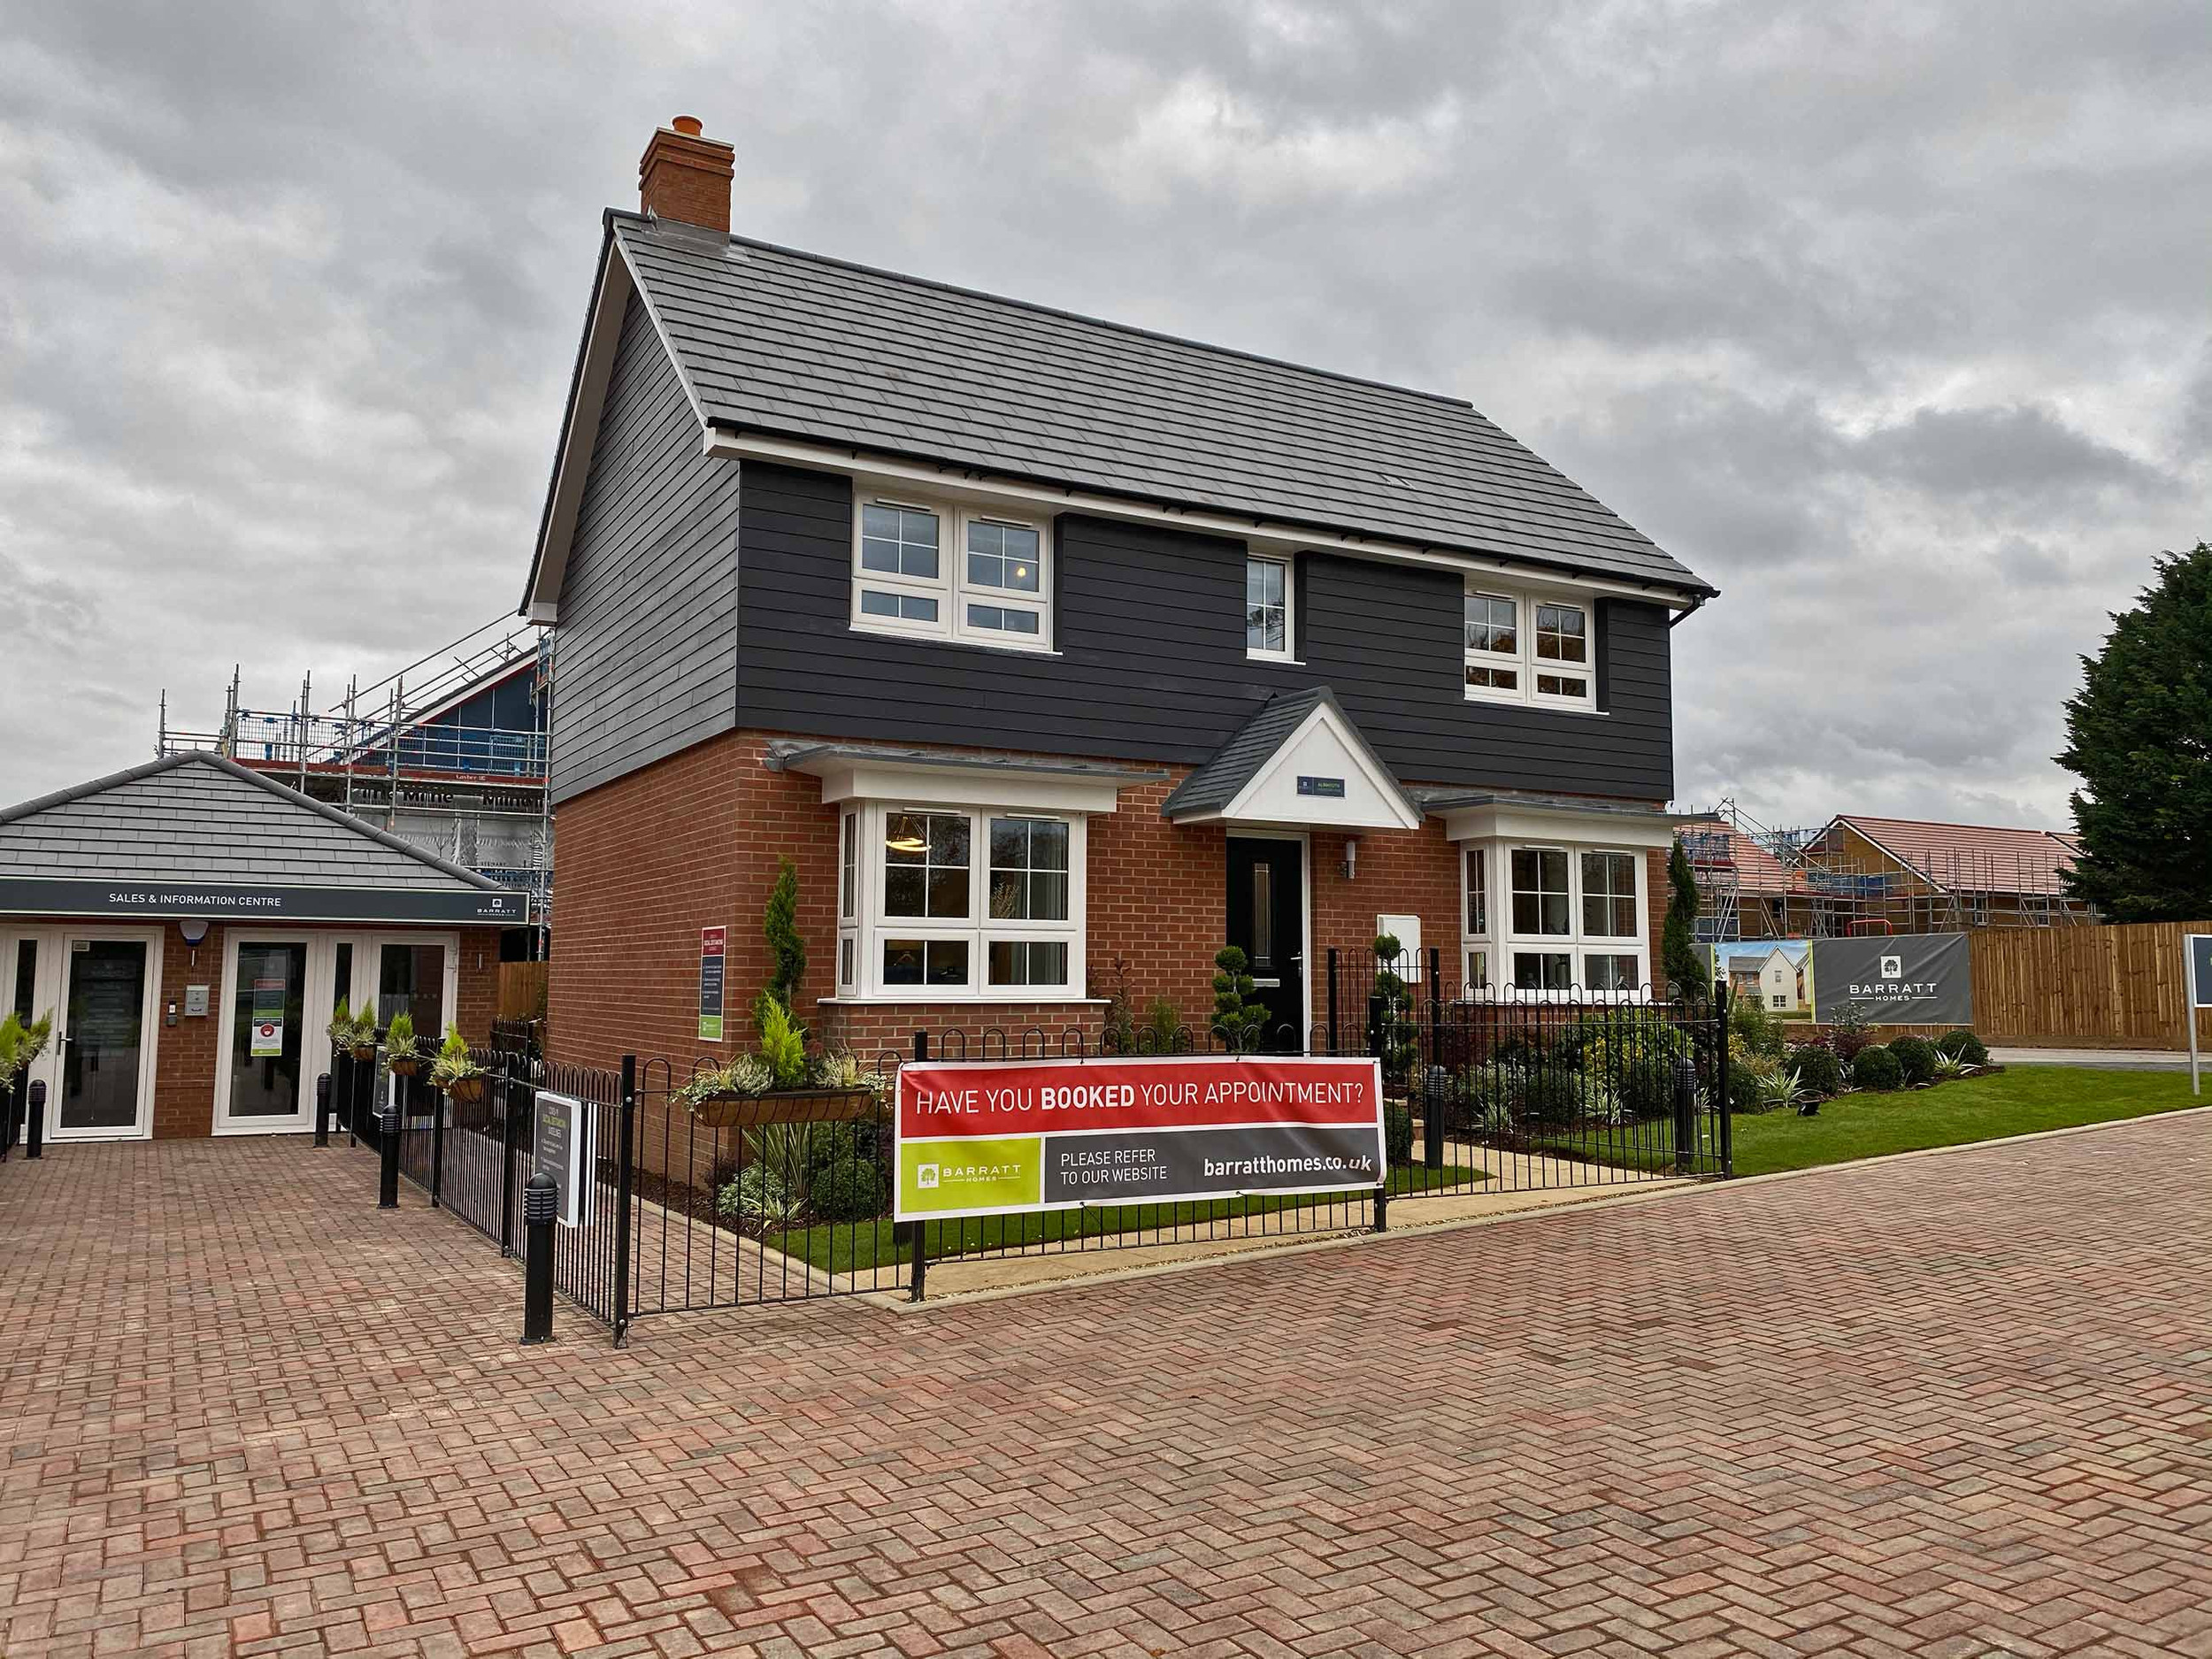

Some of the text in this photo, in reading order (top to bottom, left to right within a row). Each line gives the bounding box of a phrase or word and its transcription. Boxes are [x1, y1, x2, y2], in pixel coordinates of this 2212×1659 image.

[109, 893, 281, 907] SALES & INFORMATION CENTRE
[1849, 983, 1938, 994] BARRATT
[917, 1081, 1363, 1115] HAVE YOU BOOKED YOUR APPOINTMENT?
[1061, 1148, 1156, 1167] PLEASE REFER
[1203, 1155, 1371, 1177] barratthomes.co.uk
[943, 1164, 1021, 1178] BARRATT
[1061, 1165, 1167, 1185] TO OUR WEBSITE
